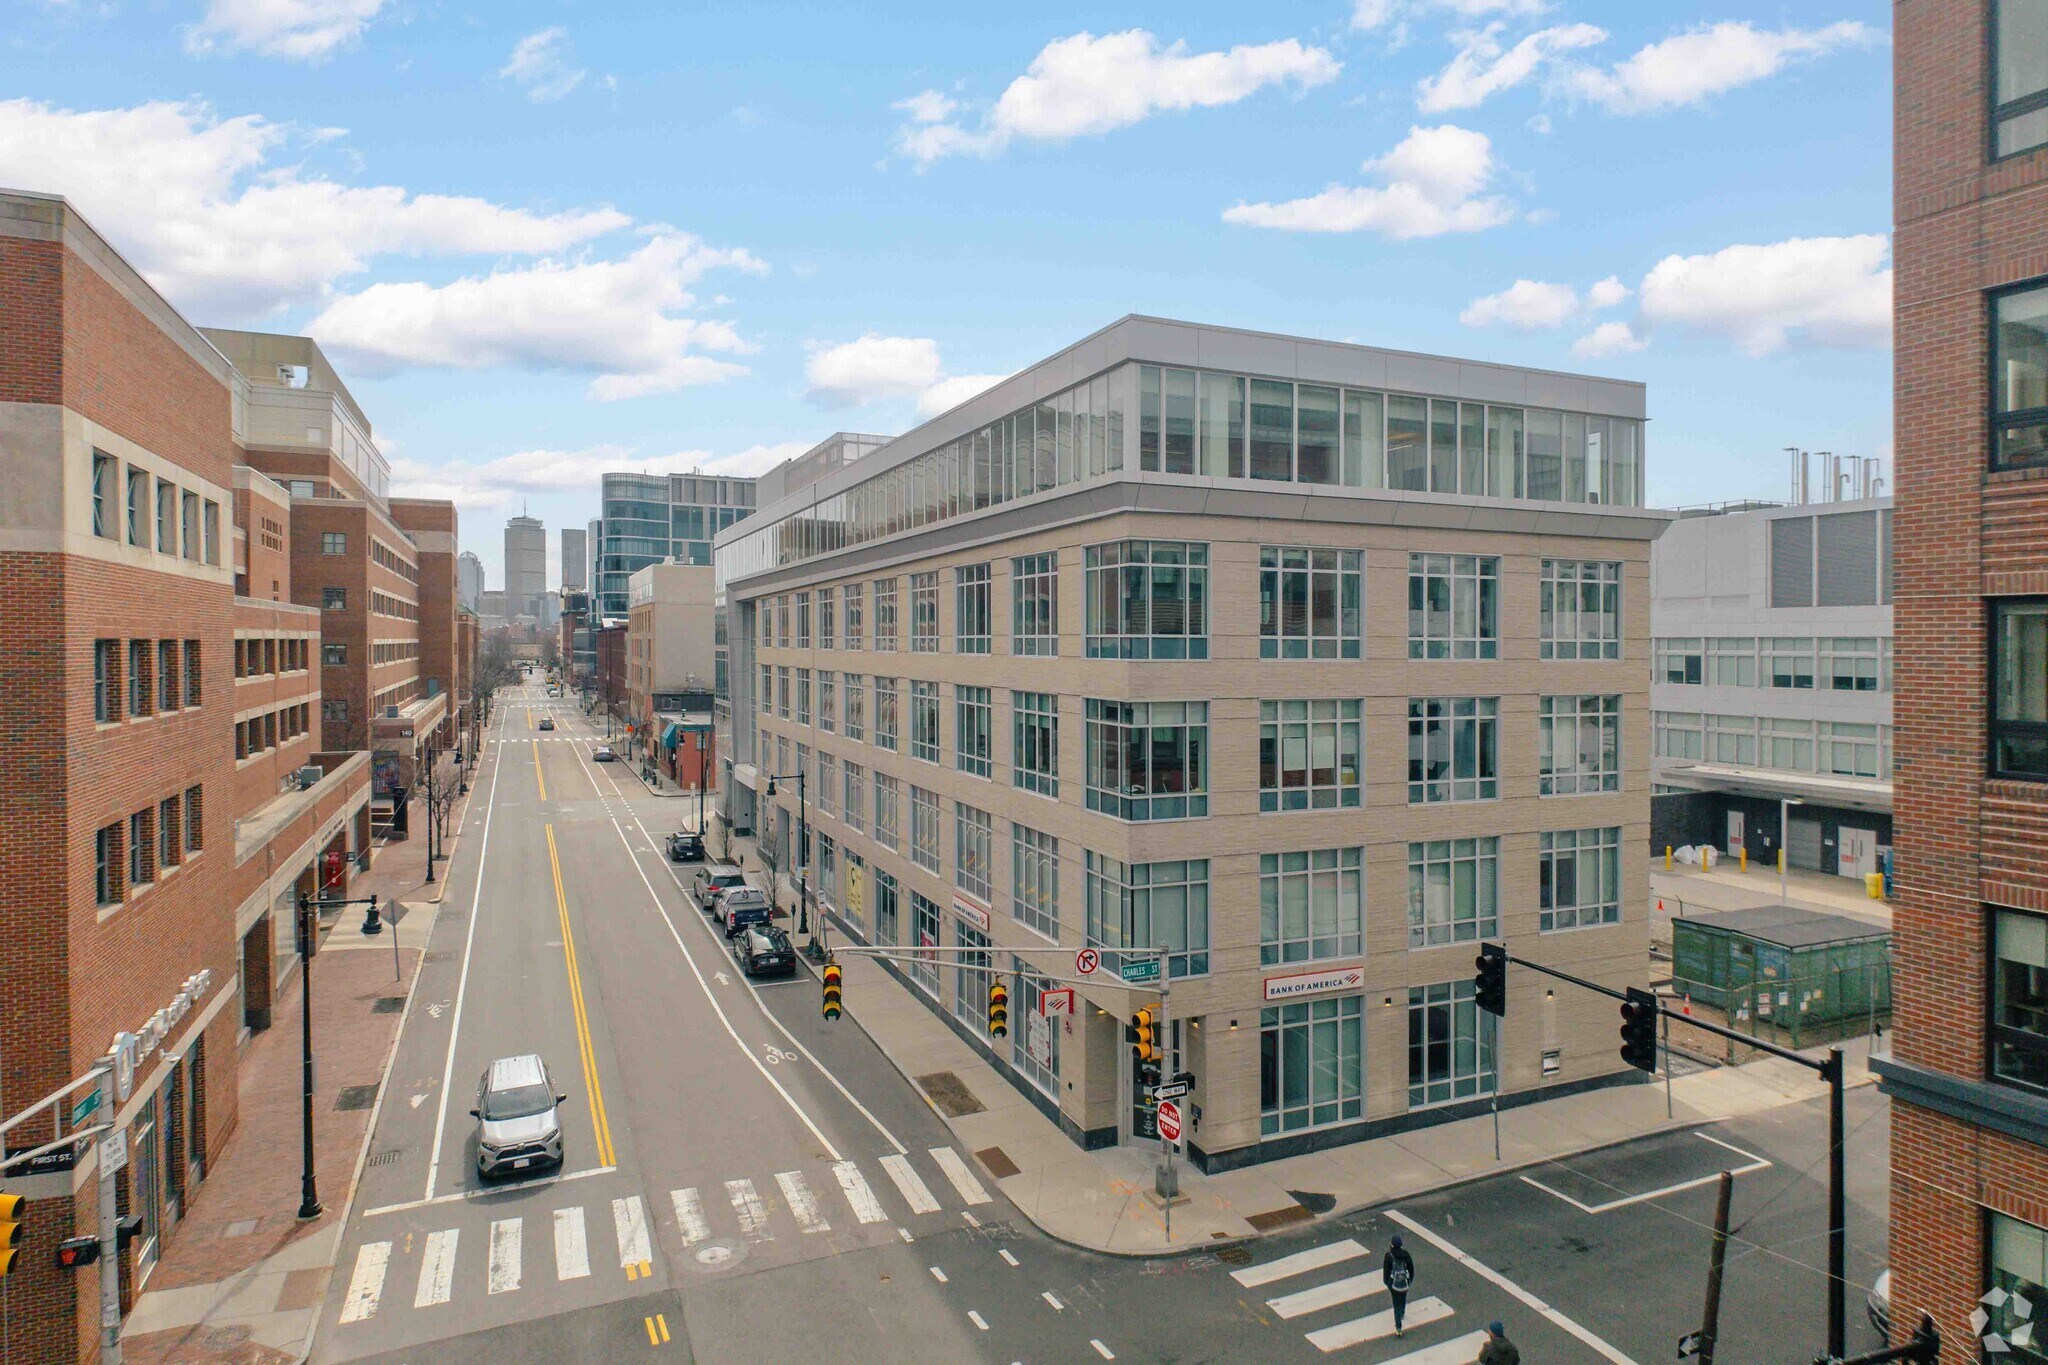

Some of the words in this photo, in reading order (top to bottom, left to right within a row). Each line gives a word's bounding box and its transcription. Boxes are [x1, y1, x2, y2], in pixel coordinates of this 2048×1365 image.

[1123, 966, 1146, 978] CHARLES
[1151, 964, 1158, 974] ST
[1270, 986, 1293, 995] BANK
[1295, 984, 1306, 992] OF
[1306, 979, 1343, 990] AMERICA
[1162, 1088, 1173, 1096] ONE
[1173, 1086, 1184, 1094] WAY
[1161, 1105, 1168, 1114] DO
[1168, 1110, 1178, 1120] NOT
[1161, 1122, 1177, 1136] ENTER
[33, 1154, 57, 1165] FIRST
[59, 1153, 73, 1161] ST.
